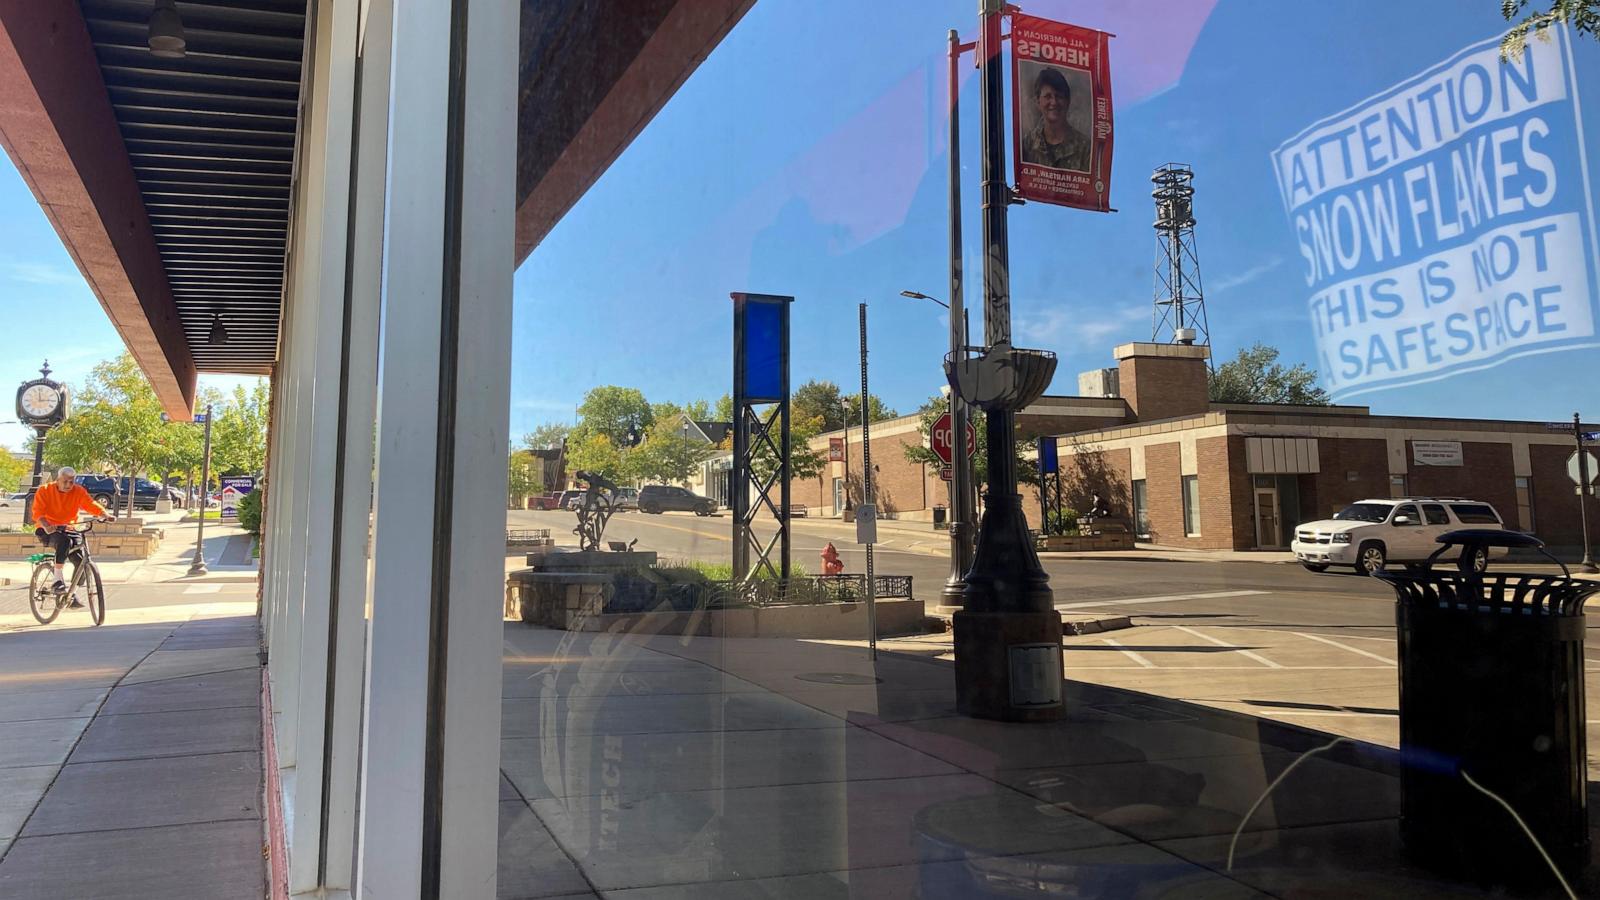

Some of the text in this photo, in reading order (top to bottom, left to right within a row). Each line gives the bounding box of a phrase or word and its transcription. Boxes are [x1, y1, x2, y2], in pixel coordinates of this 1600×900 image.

[1289, 43, 1538, 207] ATTENTION
[1312, 224, 1557, 338] THIS IS NOT
